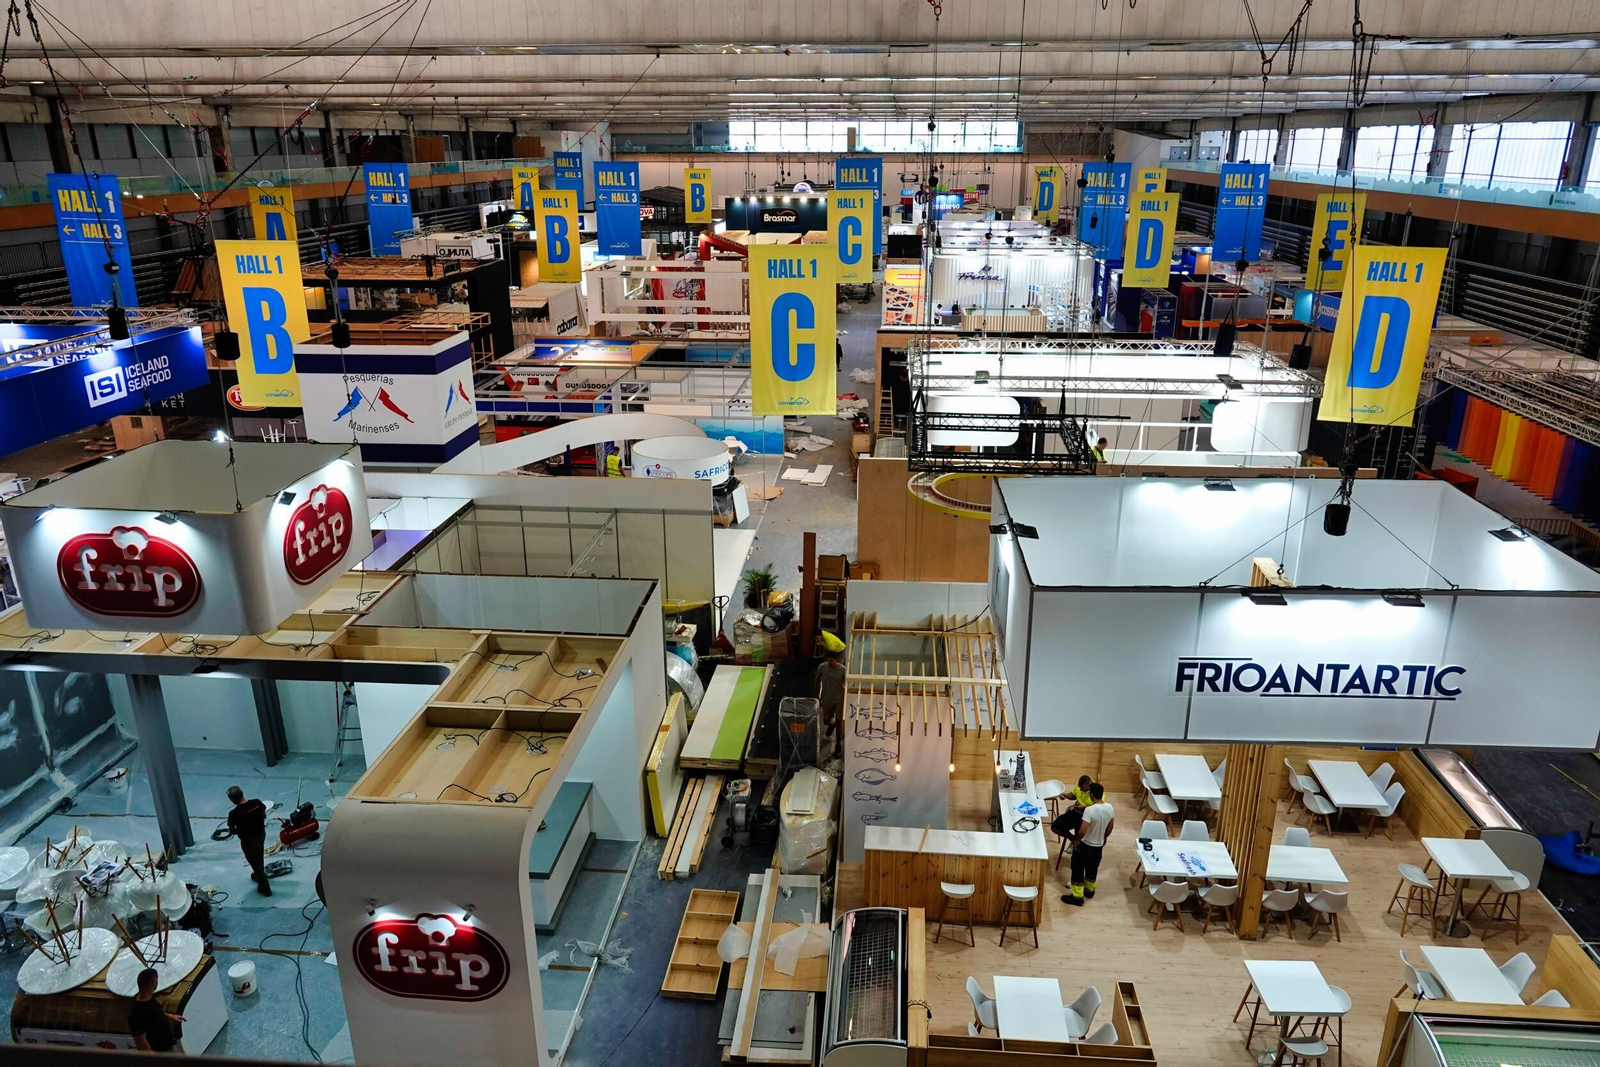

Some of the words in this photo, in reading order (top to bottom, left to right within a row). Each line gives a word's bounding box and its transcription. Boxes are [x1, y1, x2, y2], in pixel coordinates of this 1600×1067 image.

[556, 157, 574, 168] HALL
[575, 158, 580, 168] 1
[368, 172, 397, 187] HALL
[398, 172, 405, 187] 1
[598, 171, 626, 186] HALL
[629, 171, 635, 186] 1
[840, 168, 869, 183] HALL
[872, 168, 878, 182] 1
[1086, 171, 1115, 187] HALL
[1119, 172, 1126, 188] 1
[1224, 173, 1254, 189] HALL
[1258, 173, 1265, 189] 1
[57, 189, 102, 213] HALL
[104, 190, 116, 214] 1
[258, 194, 279, 206] HALL
[279, 195, 285, 206] 1
[402, 193, 408, 203] 3
[520, 182, 535, 210] A
[542, 197, 563, 208] HALL
[563, 198, 568, 208] 1
[611, 192, 630, 203] HALL
[631, 192, 637, 203] 3
[690, 183, 705, 212] B
[837, 197, 857, 209] HALL
[859, 197, 864, 209] 1
[873, 189, 880, 200] 3
[1038, 181, 1055, 211] D
[1118, 194, 1125, 205] 3
[1234, 195, 1255, 206] HALL
[1257, 195, 1264, 206] 3
[1140, 200, 1161, 212] HALL
[1164, 200, 1169, 212] 1
[1326, 201, 1348, 213] HALL
[763, 213, 797, 222] Brasmar
[81, 223, 111, 239] HALL
[112, 224, 122, 240] 3
[544, 214, 571, 264] B
[838, 215, 862, 265] C
[1134, 218, 1164, 269] D
[1321, 220, 1349, 271] E
[235, 254, 272, 274] HALL
[274, 255, 283, 274] 1
[767, 258, 805, 279] HALL
[809, 258, 817, 278] 1
[1366, 260, 1408, 282] HALL
[1414, 262, 1424, 283] 1
[242, 286, 294, 375] B
[770, 292, 816, 382] C
[1346, 295, 1411, 389] D
[124, 355, 169, 380] ICELAND
[89, 372, 123, 401] ISI
[127, 368, 172, 393] SEAFOOD
[347, 419, 400, 434] Marinenses
[292, 511, 345, 566] frip
[74, 545, 183, 607] frip
[1175, 661, 1467, 696] FRIOANTARTIC
[371, 931, 491, 991] frip
